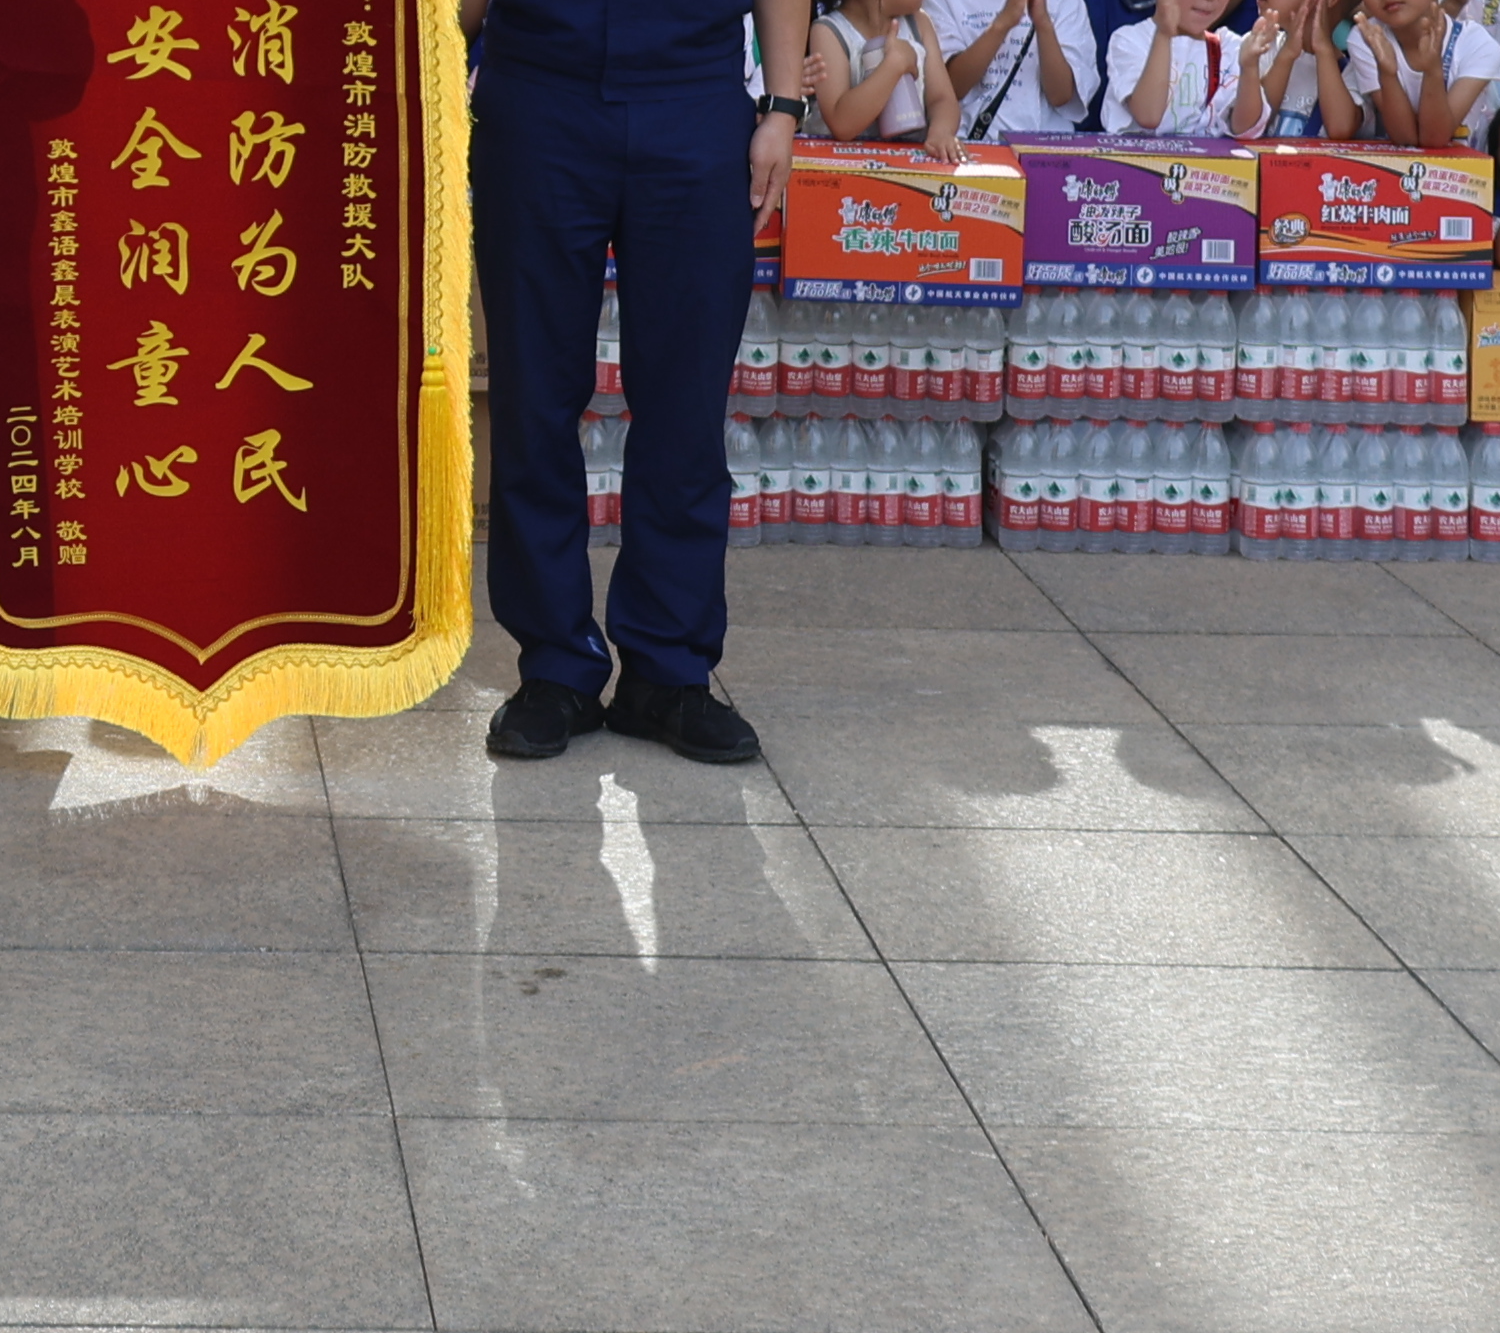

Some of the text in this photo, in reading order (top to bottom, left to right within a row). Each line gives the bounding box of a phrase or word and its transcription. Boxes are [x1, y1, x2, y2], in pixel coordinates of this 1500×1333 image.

[1079, 178, 1118, 201] 康师傅
[1336, 177, 1377, 201] 康师傅
[857, 200, 898, 224] 康师傅
[1321, 205, 1409, 225] 红烧牛肉面
[1274, 219, 1306, 235] 经典
[1069, 220, 1151, 246] 酸汤面
[833, 226, 959, 254] 香辣牛肉面
[106, 4, 203, 499] 安全润童心
[1159, 272, 1248, 281] 中国航天事业合作伙伴
[1399, 270, 1485, 279] 中国航天事业合作伙伴
[927, 290, 1017, 300] 中国航天事业合作伙伴
[47, 138, 88, 567] 敦煌市鑫语鑫晨表演艺术培训学校 敬赠
[743, 372, 772, 382] 农夫山泉
[815, 372, 842, 382] 农夫山泉
[855, 374, 884, 384] 农夫山泉
[1017, 373, 1046, 384] 农夫山泉
[1163, 375, 1193, 385] 农夫山泉
[796, 498, 825, 508] 农夫山泉
[1010, 505, 1038, 515] 农夫山泉
[1041, 505, 1069, 515] 农夫山泉
[1156, 508, 1186, 518] 农夫山泉
[1193, 508, 1222, 518] 农夫山泉
[1364, 515, 1392, 524] 农夫山泉
